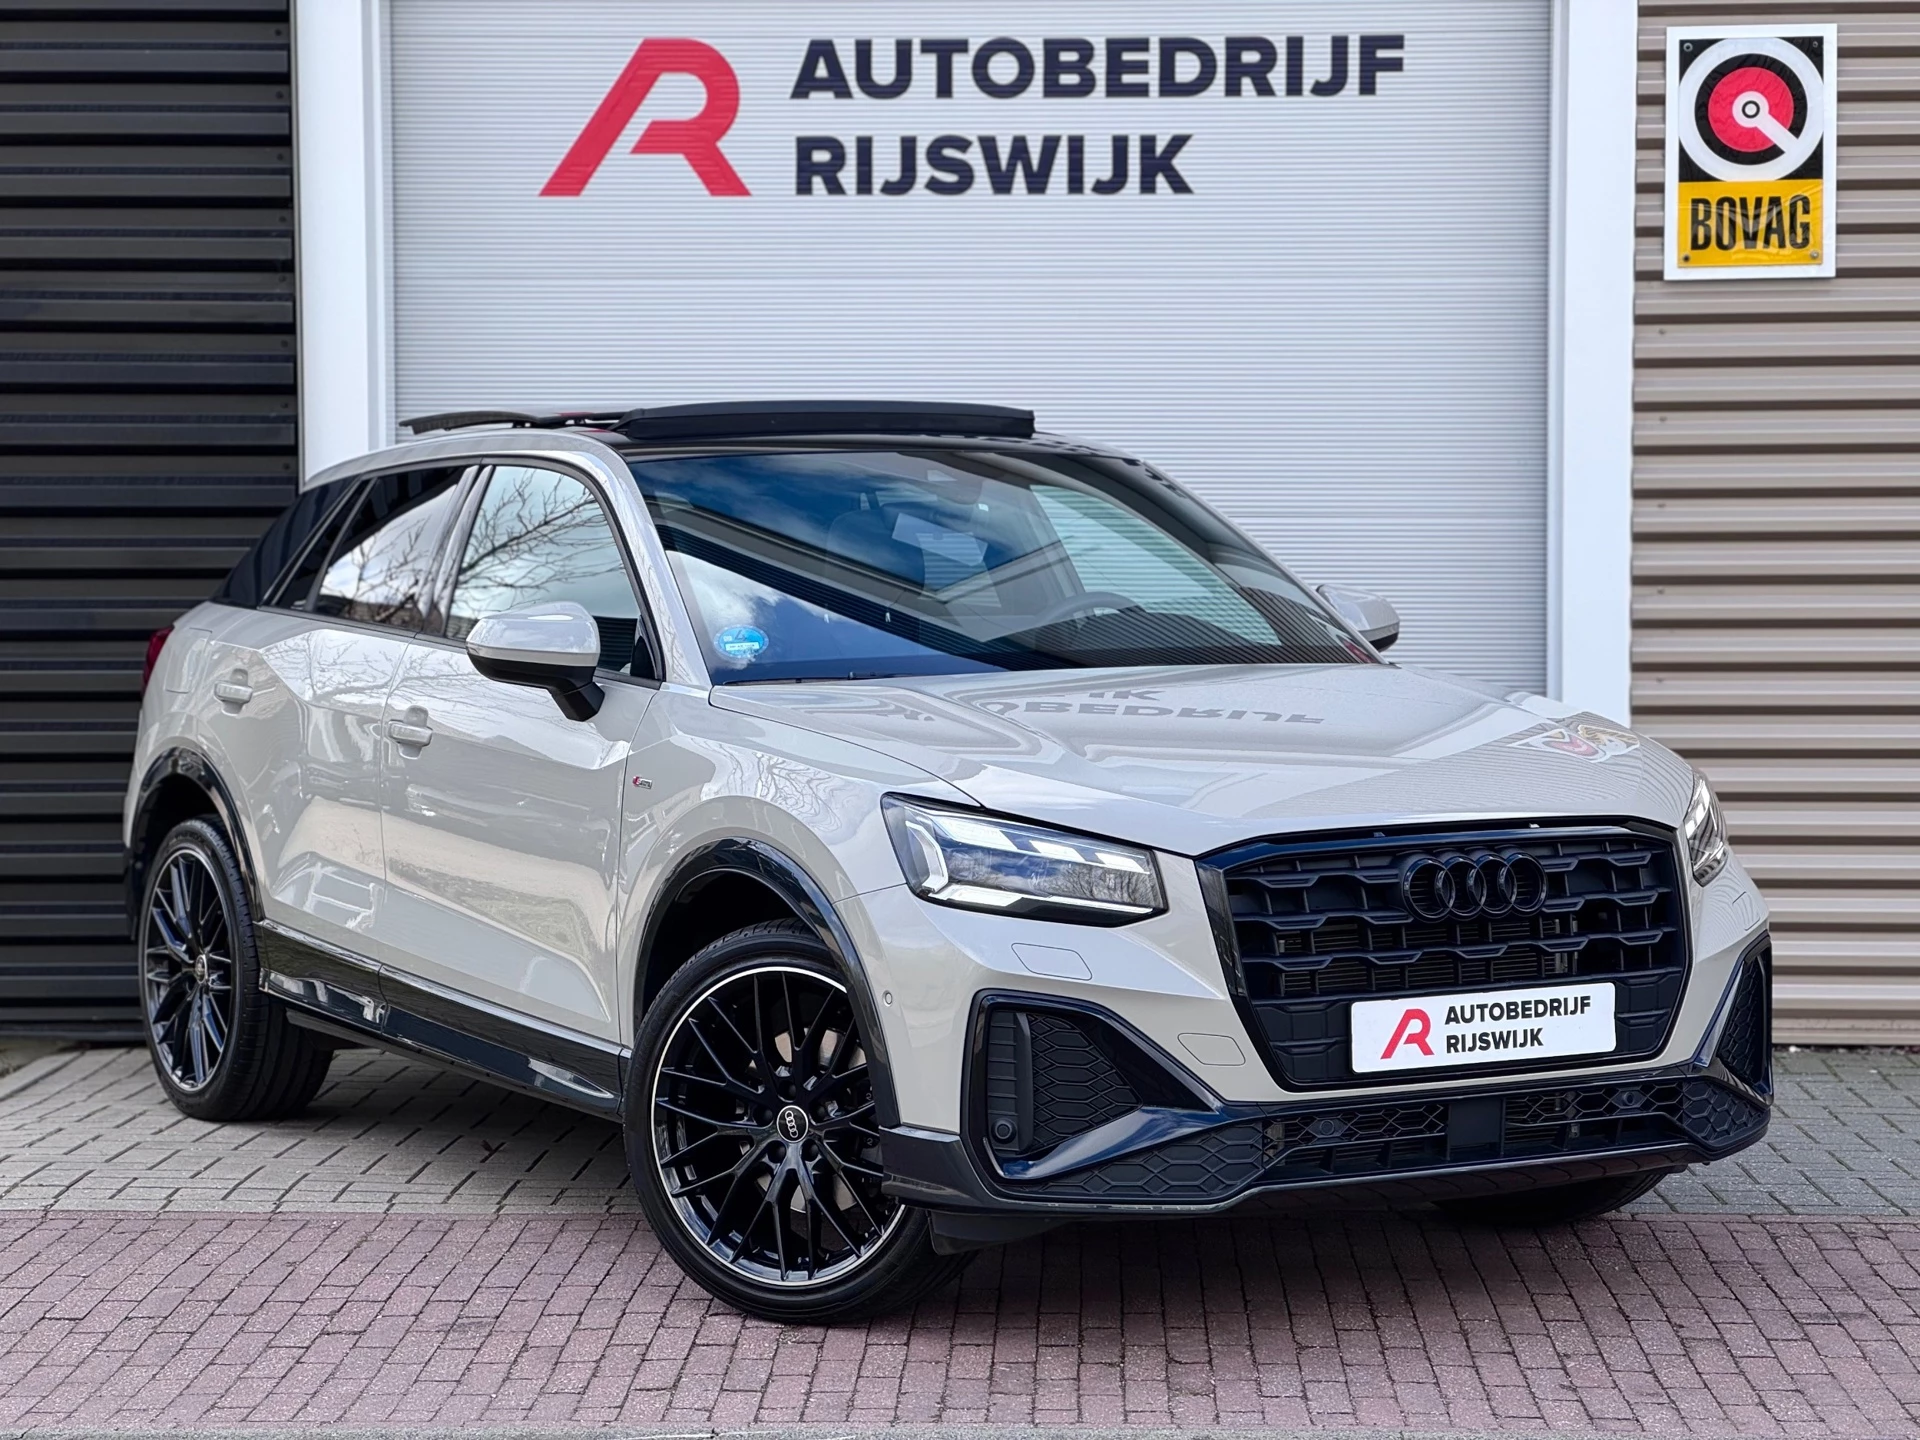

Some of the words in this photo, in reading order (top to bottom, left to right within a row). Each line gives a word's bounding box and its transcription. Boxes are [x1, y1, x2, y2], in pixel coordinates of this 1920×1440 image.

[790, 35, 1405, 100] AUTOBEDRIJF
[796, 134, 1194, 196] RIJSWIJK
[1690, 195, 1811, 251] BOVAG
[1445, 995, 1591, 1025] AUTOBEDRIJF
[1446, 1027, 1544, 1054] RIJSWIJK
